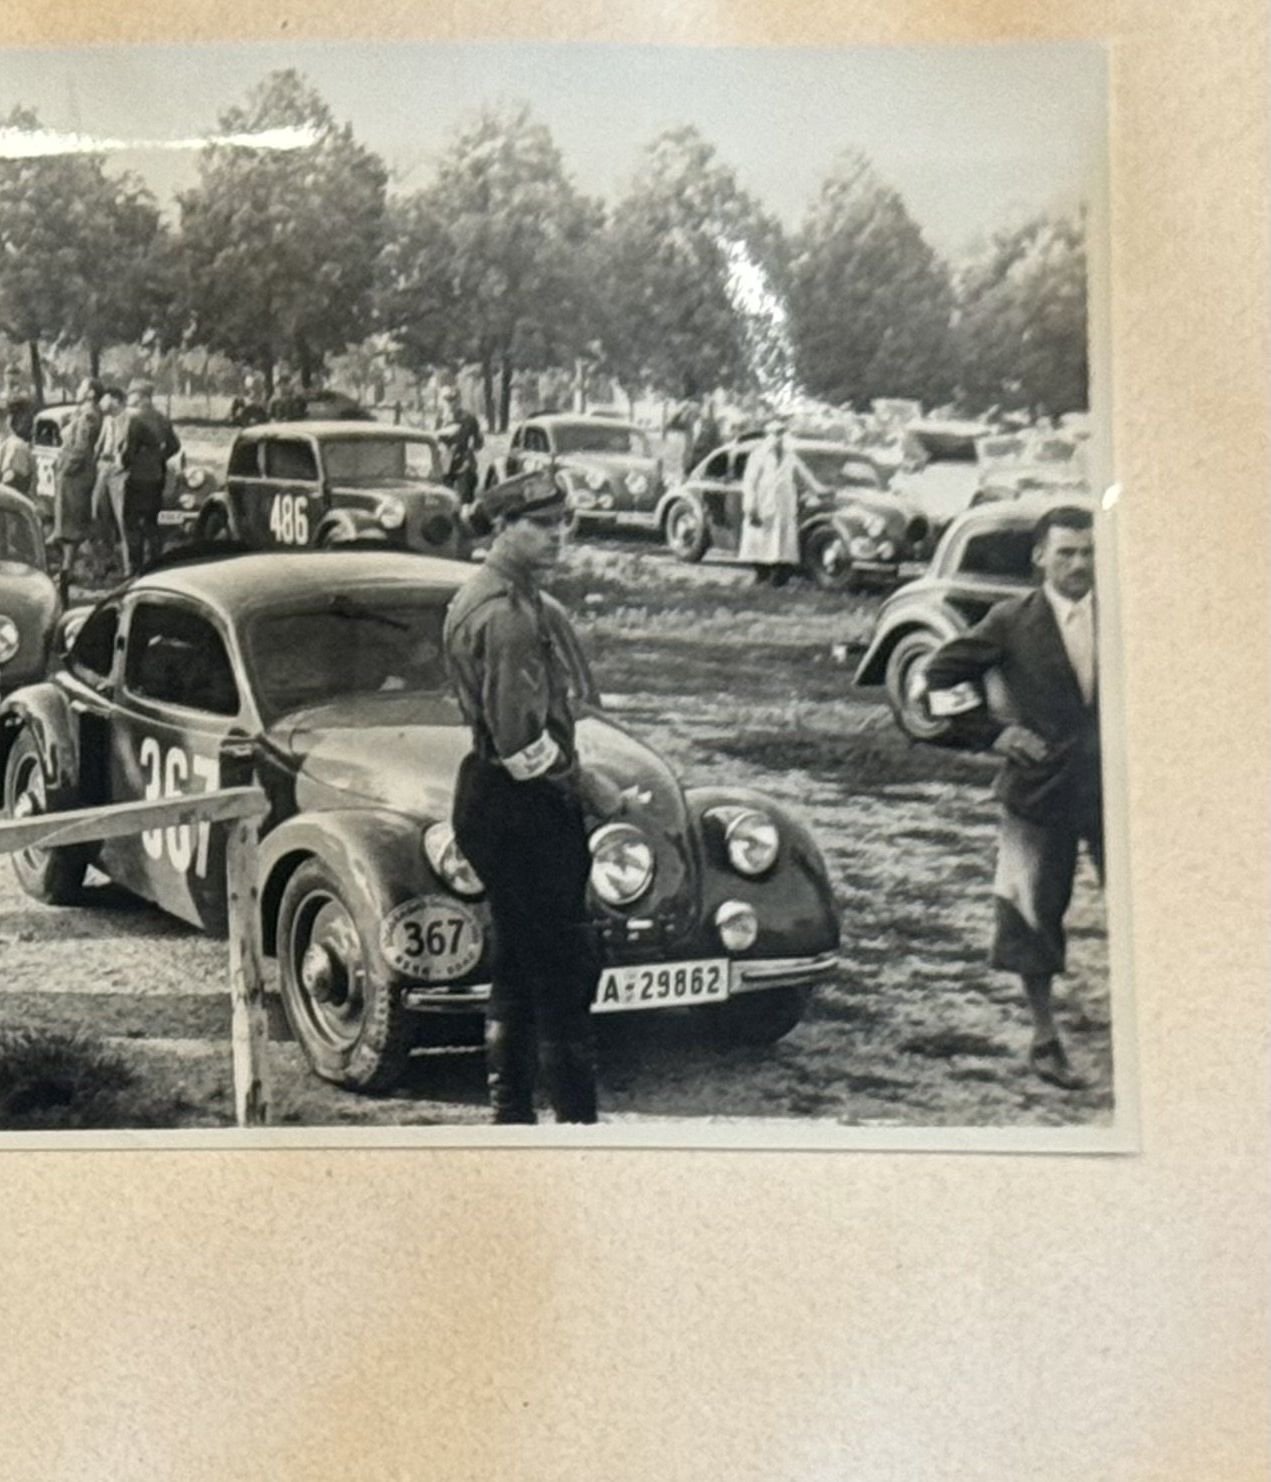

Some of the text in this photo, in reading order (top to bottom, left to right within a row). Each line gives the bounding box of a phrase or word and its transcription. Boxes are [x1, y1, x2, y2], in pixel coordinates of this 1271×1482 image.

[269, 493, 309, 545] 486
[140, 737, 220, 879] 367
[403, 918, 465, 957] 367
[640, 965, 721, 1001] 29862
